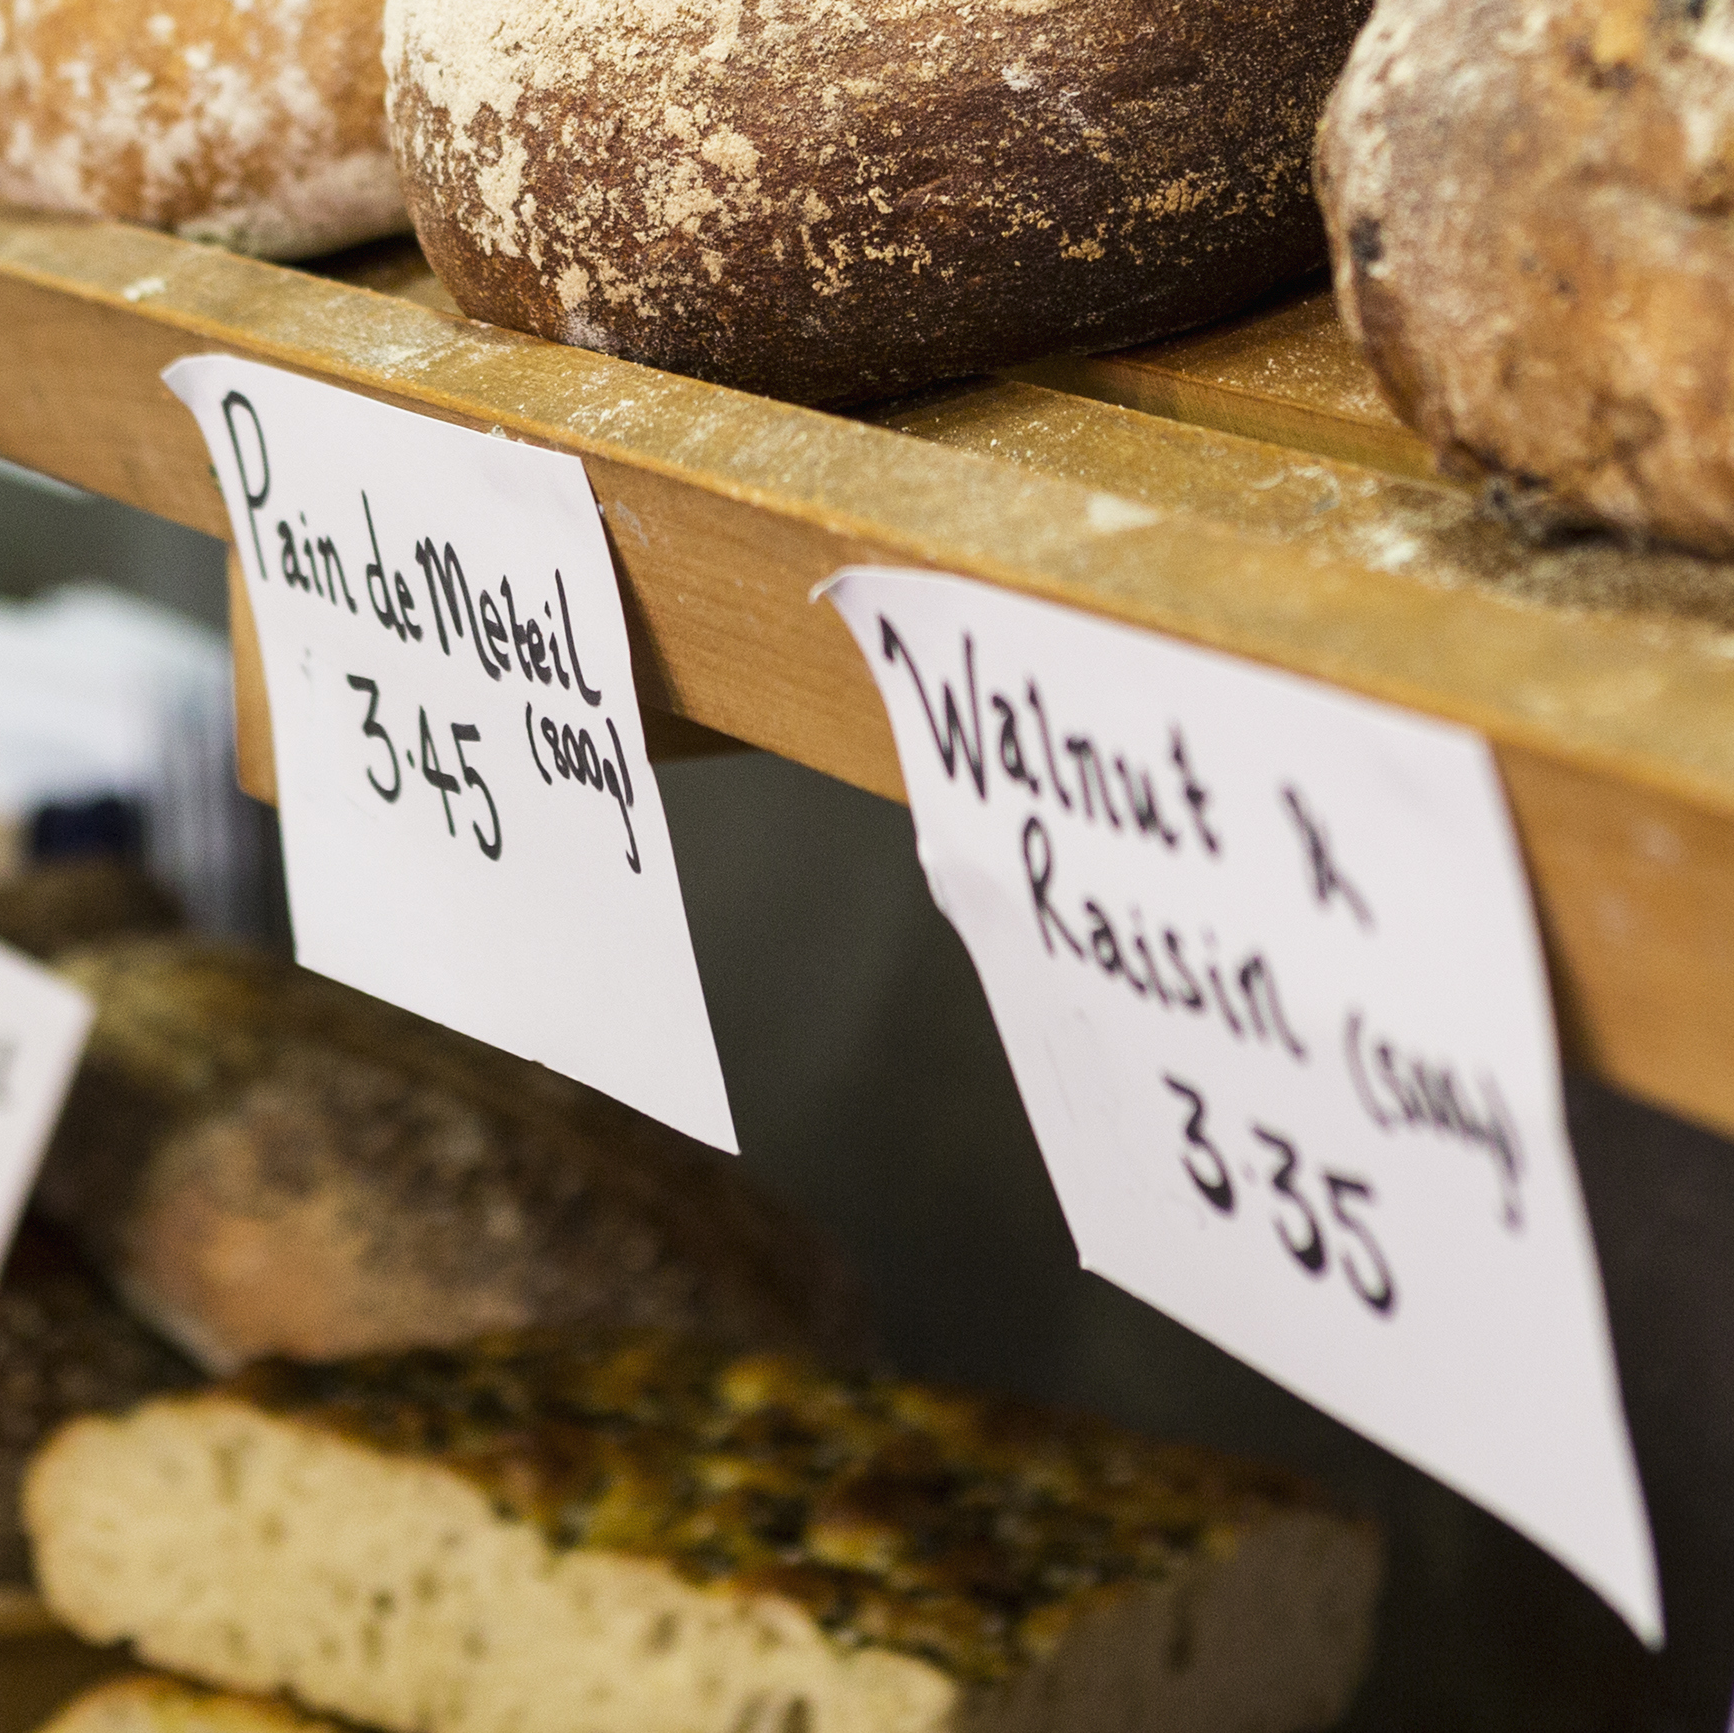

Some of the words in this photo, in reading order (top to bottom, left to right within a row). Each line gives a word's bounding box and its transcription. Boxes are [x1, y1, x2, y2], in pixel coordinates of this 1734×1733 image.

[221, 389, 358, 615] Pain
[362, 490, 425, 643] de
[415, 535, 603, 708] Meteil
[347, 672, 503, 862] 3.45
[878, 612, 1224, 861] Walnut
[1018, 814, 1312, 1064] Raisin
